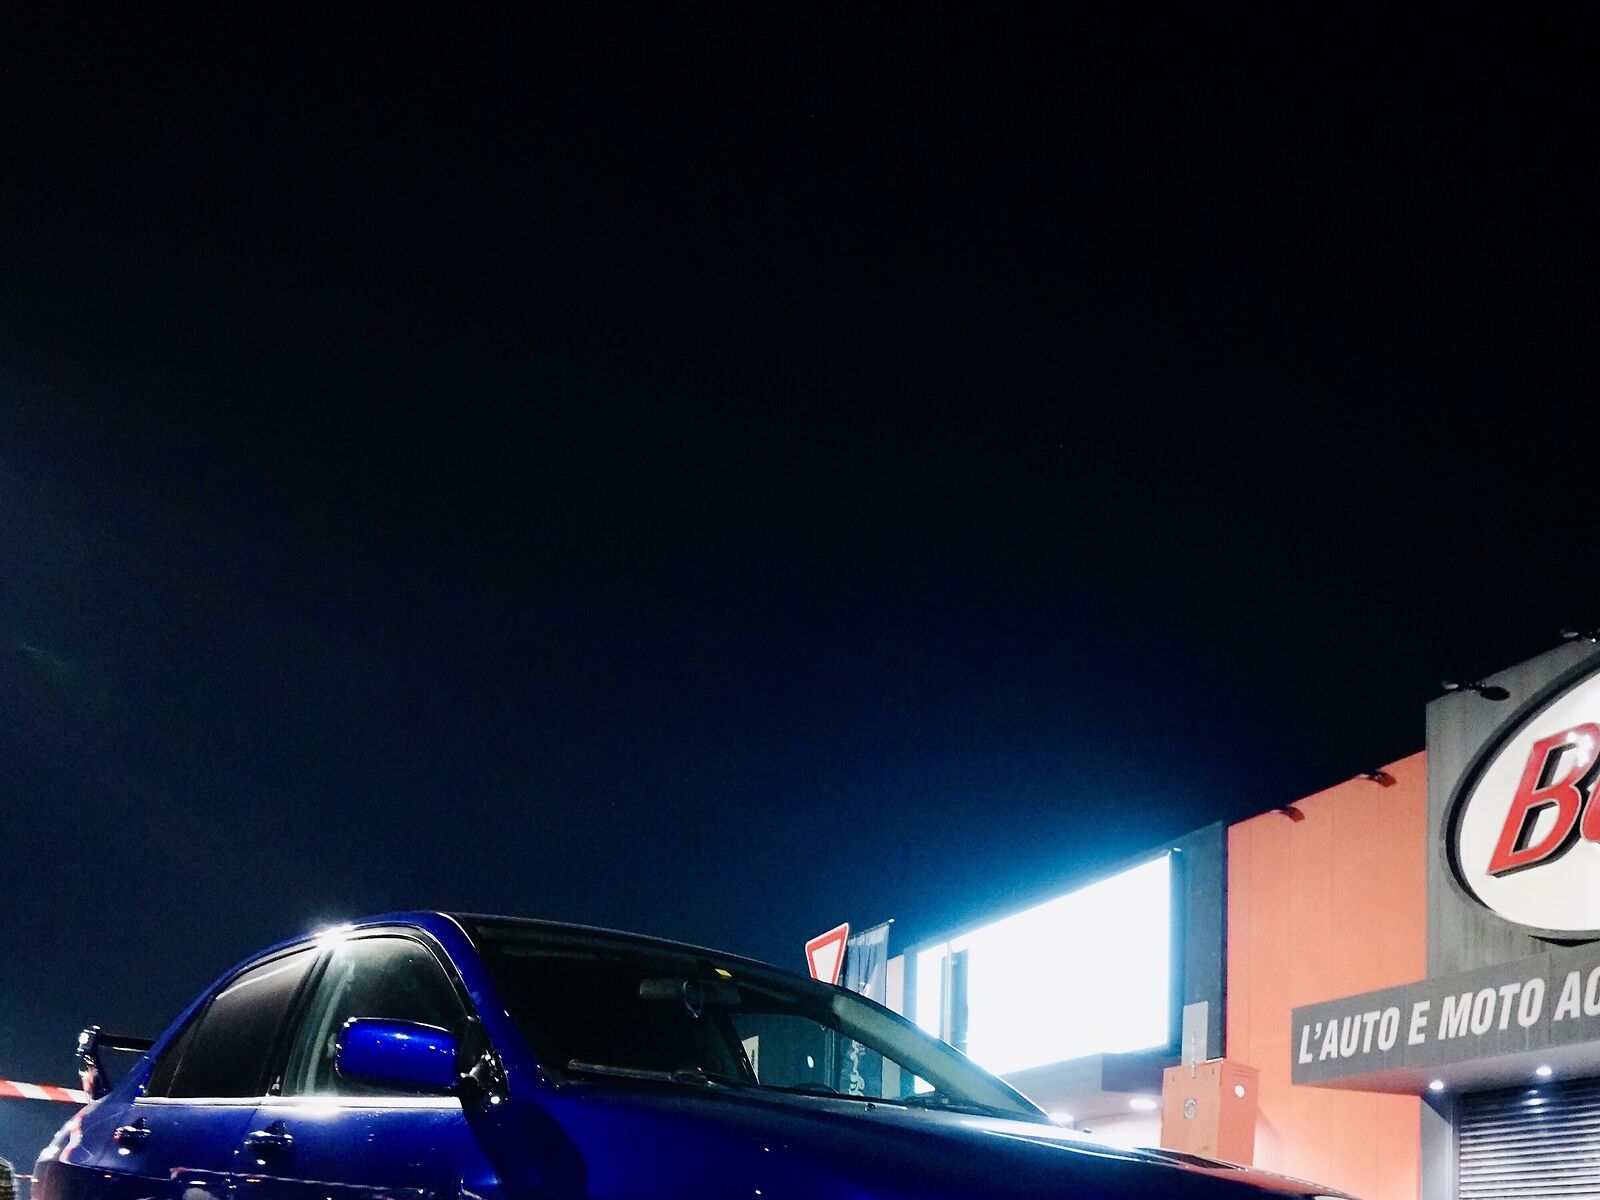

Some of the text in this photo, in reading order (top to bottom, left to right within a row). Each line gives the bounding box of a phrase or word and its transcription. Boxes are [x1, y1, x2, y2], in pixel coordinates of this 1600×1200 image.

[1299, 1006, 1401, 1064] L'AUTO
[1407, 1000, 1431, 1046] E
[1437, 977, 1546, 1041] MOTO
